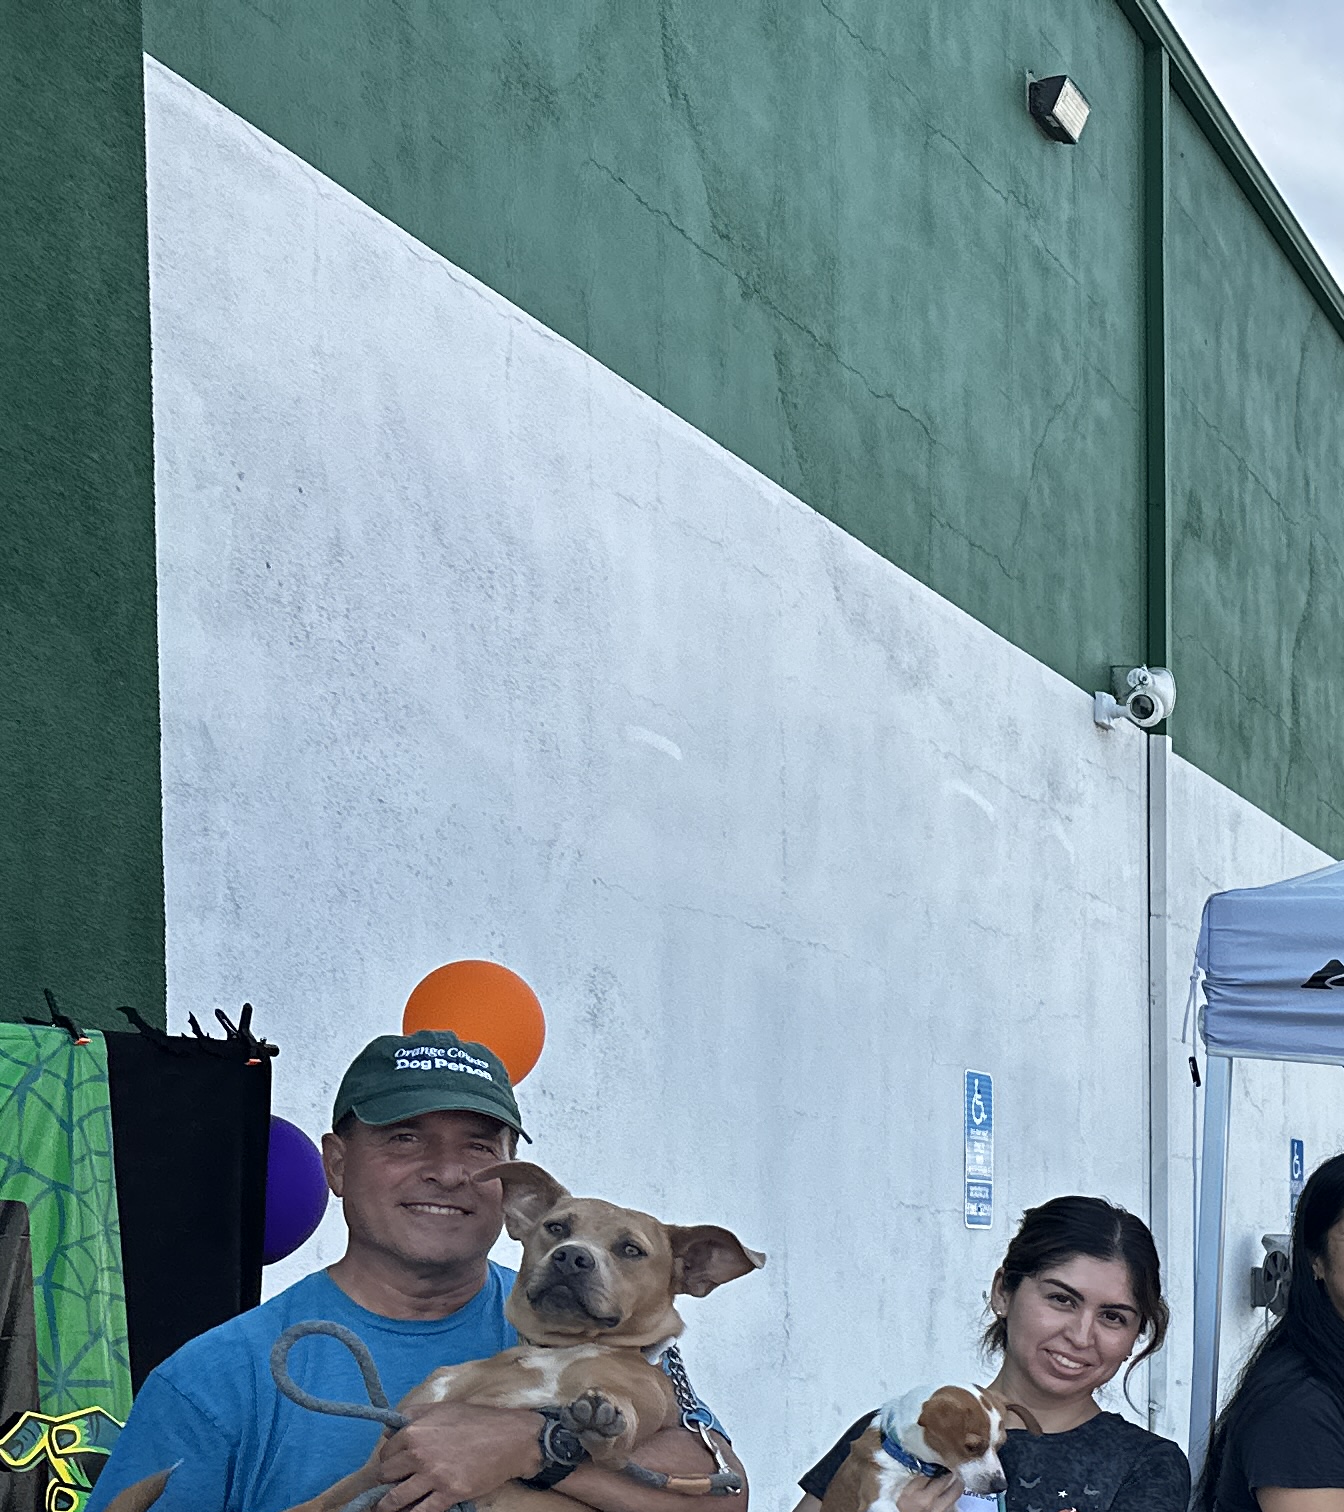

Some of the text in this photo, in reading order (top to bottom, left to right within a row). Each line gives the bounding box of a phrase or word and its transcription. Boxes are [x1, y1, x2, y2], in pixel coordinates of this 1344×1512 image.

[394, 1046, 446, 1058] Orange
[394, 1057, 493, 1081] Dog Person
